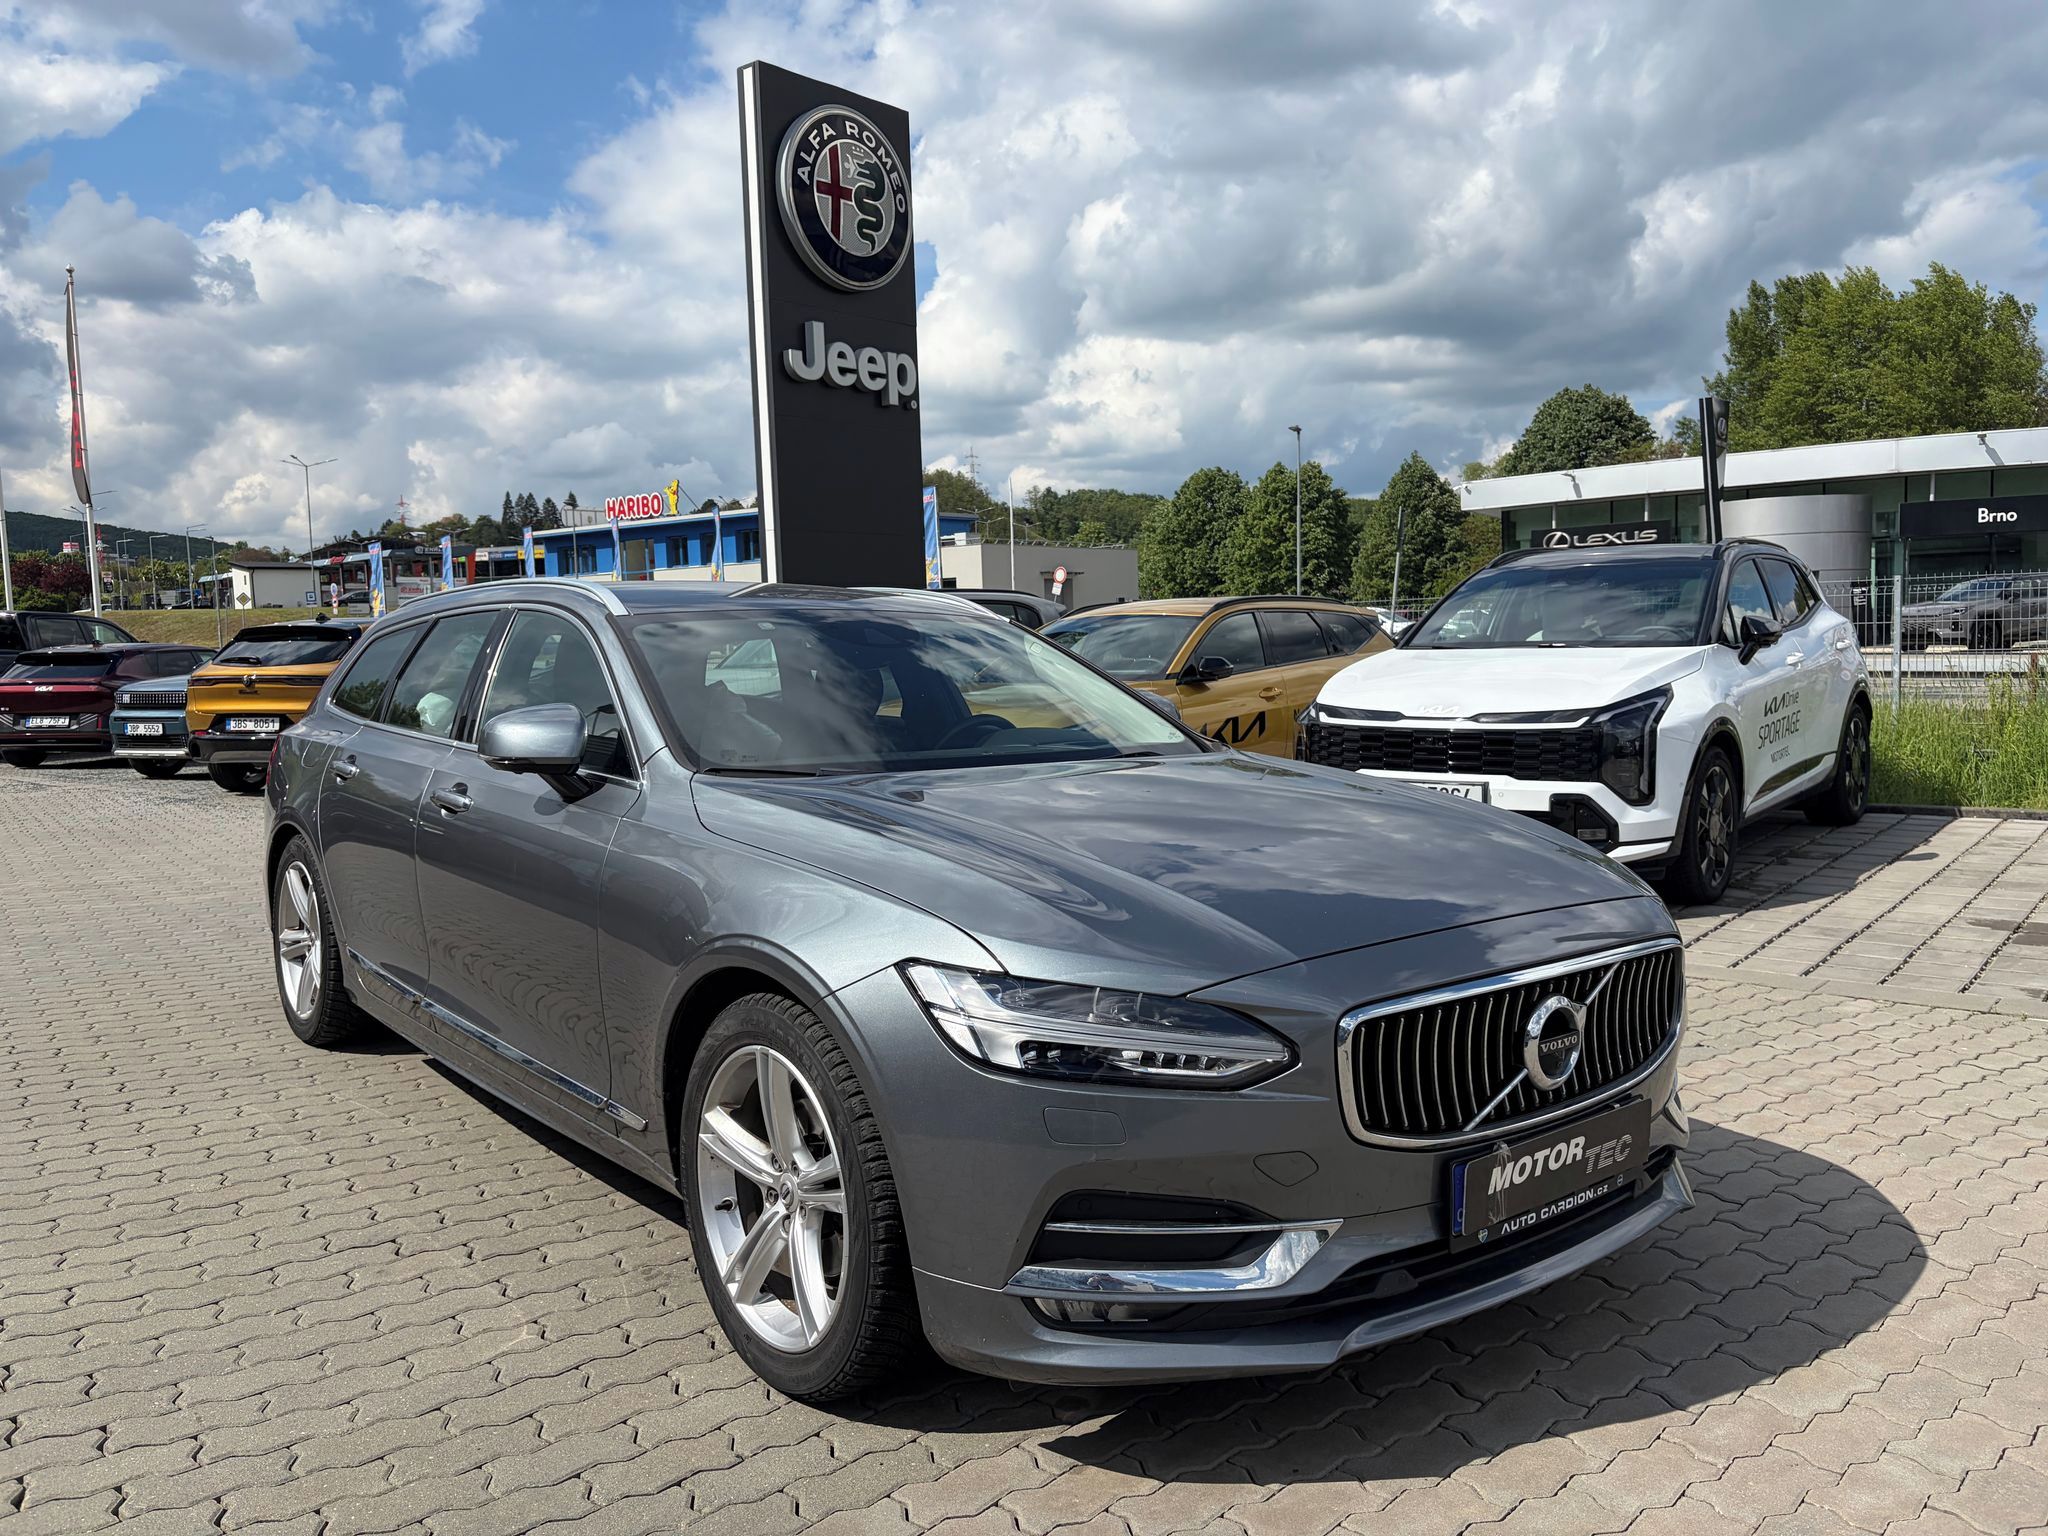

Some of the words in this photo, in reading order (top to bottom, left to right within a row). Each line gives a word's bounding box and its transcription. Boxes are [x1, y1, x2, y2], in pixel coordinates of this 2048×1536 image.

[797, 122, 837, 186] ALFA
[844, 120, 906, 214] ROMEO
[783, 320, 917, 407] Jeep
[604, 492, 663, 521] HARIBO
[1977, 507, 2018, 524] Brno
[1573, 529, 1658, 547] LEXUS
[1764, 692, 1786, 717] KIA
[231, 718, 248, 729] 3BS
[253, 718, 276, 729] 8051
[1758, 709, 1801, 750] SPORTAGE
[1540, 1035, 1578, 1053] VOLVO
[1501, 1212, 1537, 1235] AUTO
[1540, 1184, 1609, 1220] CARDION.cz
